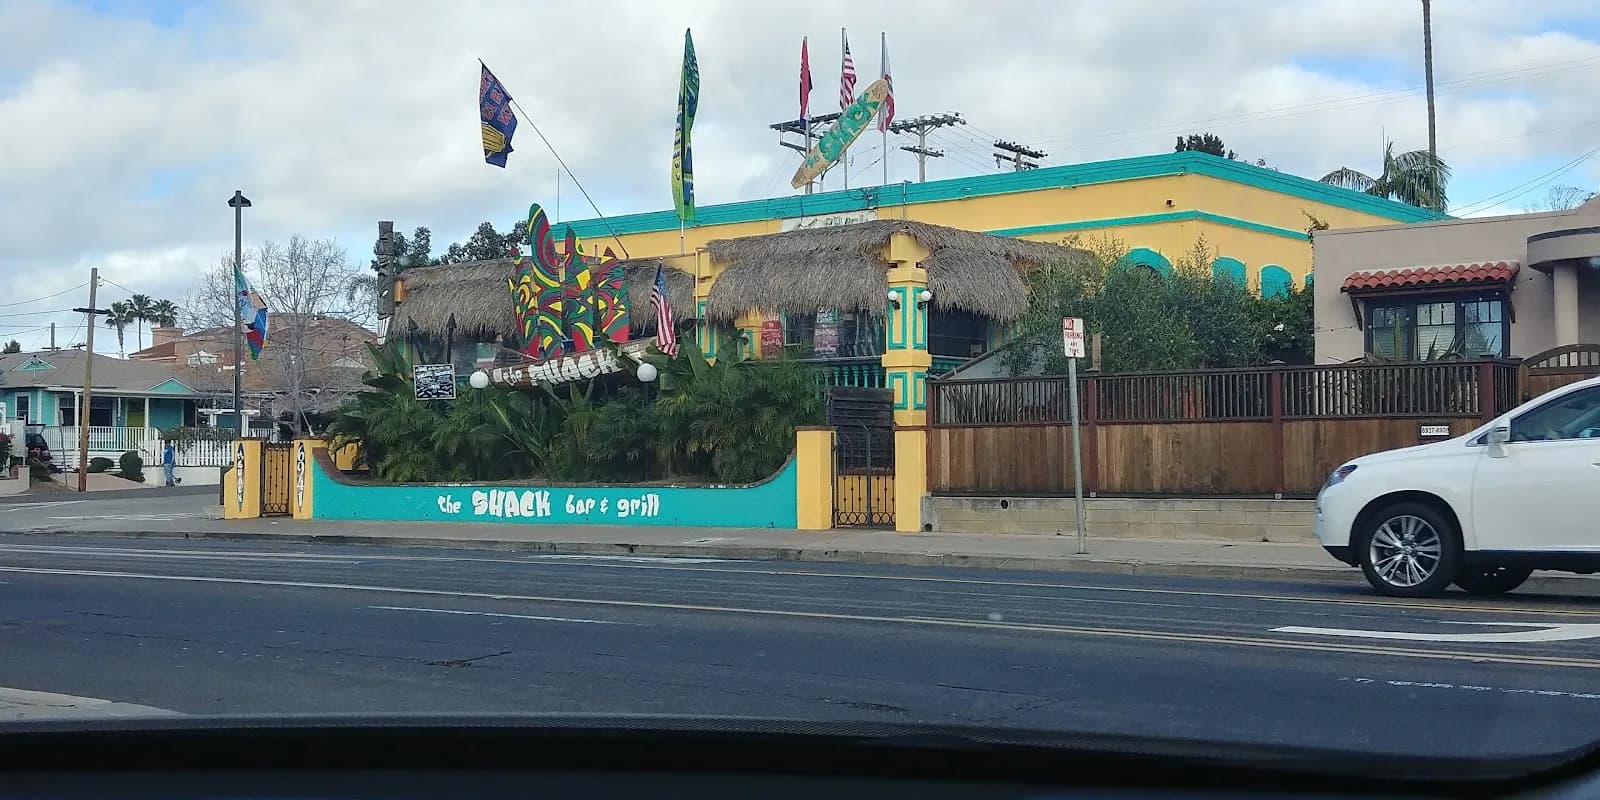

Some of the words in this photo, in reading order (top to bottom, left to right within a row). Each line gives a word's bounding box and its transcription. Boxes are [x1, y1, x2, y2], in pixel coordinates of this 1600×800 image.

[819, 93, 880, 162] SHACK
[1064, 319, 1073, 330] NO
[1064, 332, 1083, 340] PARKING
[527, 348, 624, 387] SHACK
[296, 444, 305, 507] 6941
[437, 495, 462, 514] the
[471, 489, 551, 518] SHACK
[565, 494, 596, 515] bar
[599, 497, 609, 515] &
[617, 493, 660, 518] grill
